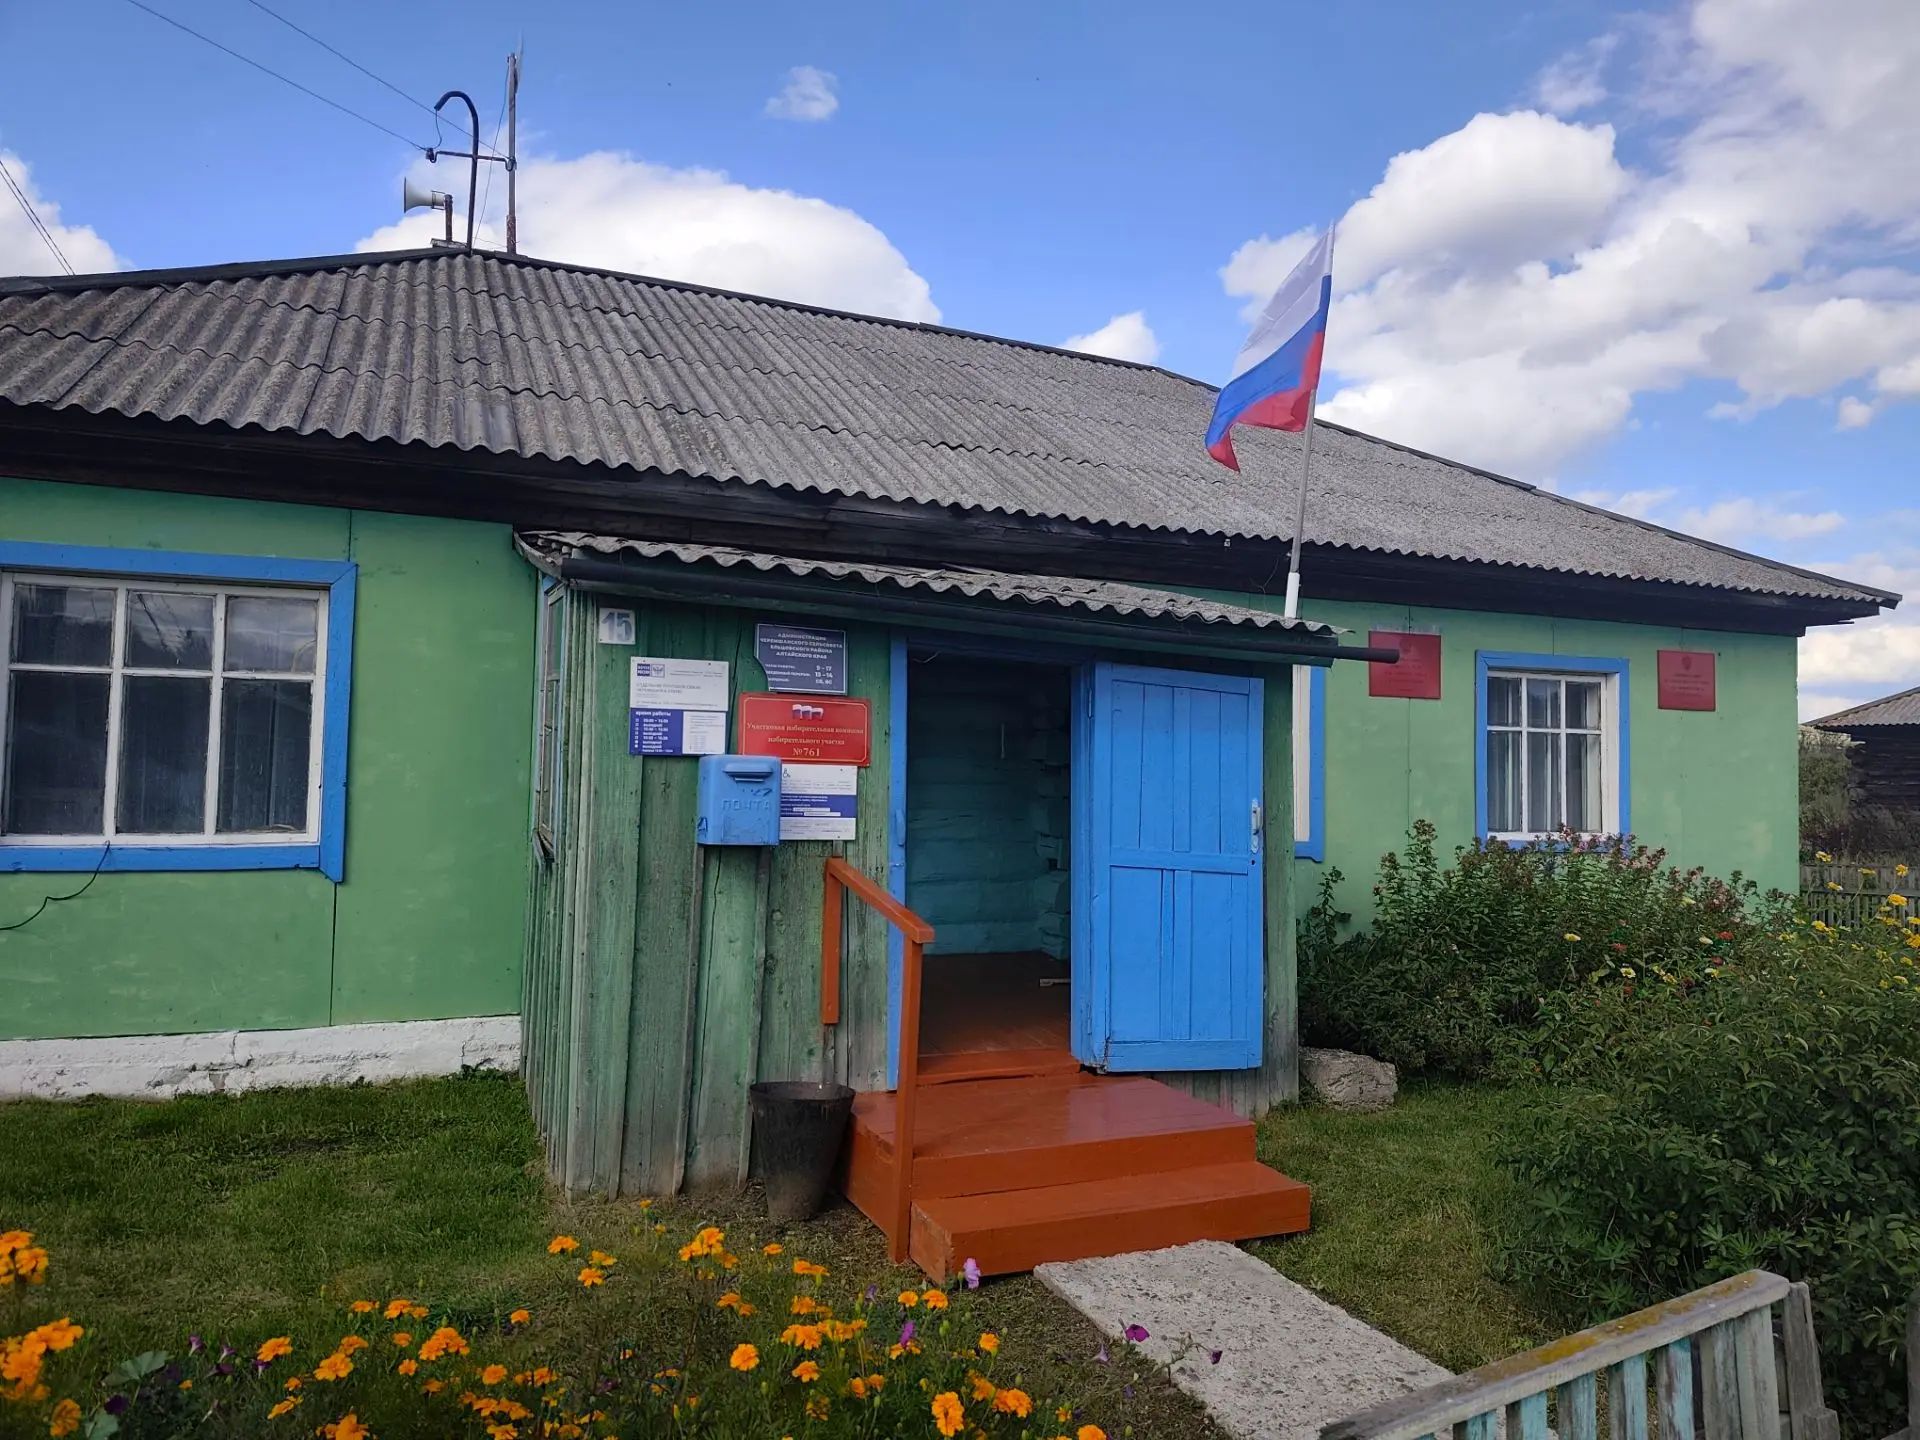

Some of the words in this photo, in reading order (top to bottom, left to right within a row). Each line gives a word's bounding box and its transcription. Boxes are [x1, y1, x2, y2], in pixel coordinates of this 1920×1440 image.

[601, 612, 632, 641] 15
[777, 633, 826, 641] АДМИНИСТРАЦИЯ
[746, 722, 785, 731] Участковая
[786, 723, 834, 733] избирательная
[767, 735, 820, 745] избирательного
